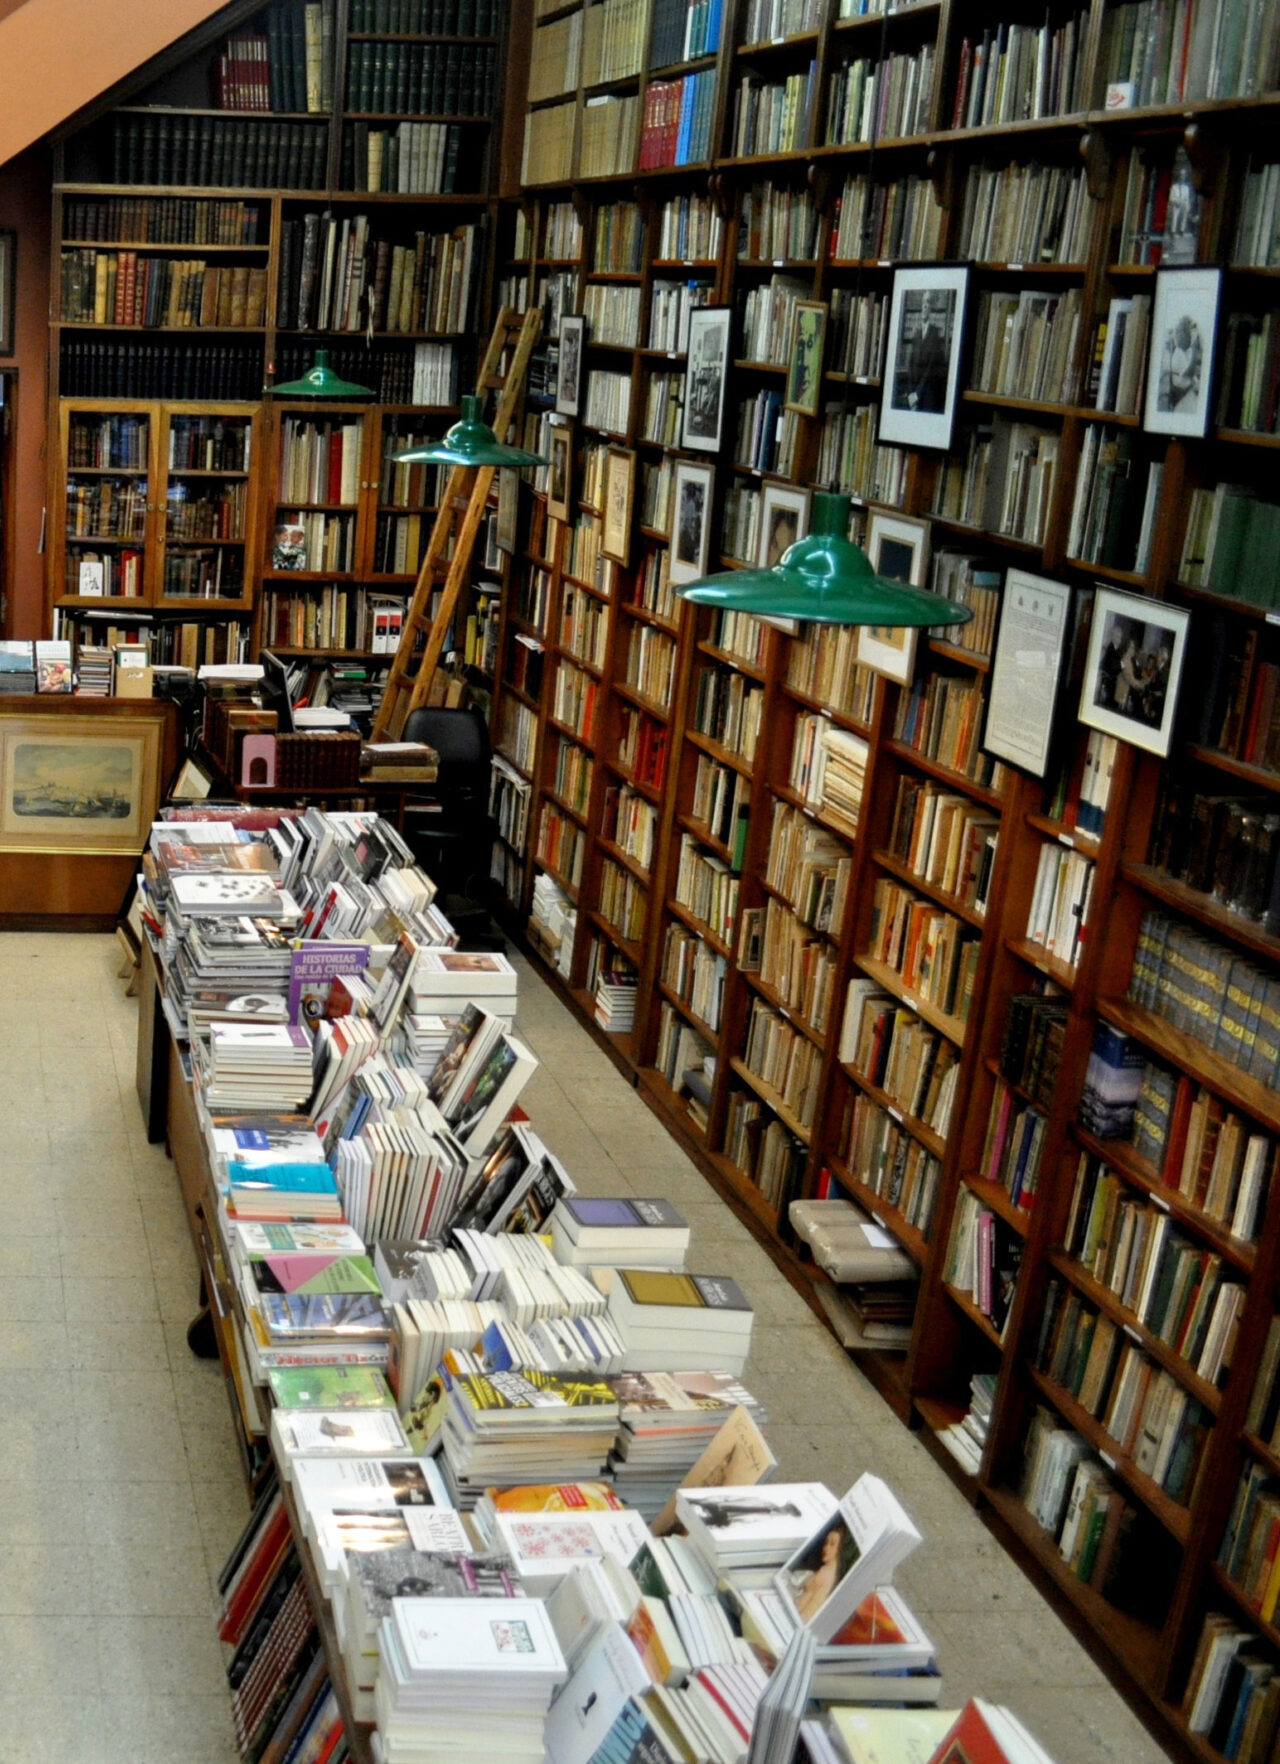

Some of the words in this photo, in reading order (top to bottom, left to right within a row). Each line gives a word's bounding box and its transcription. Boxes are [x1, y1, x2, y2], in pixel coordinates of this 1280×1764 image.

[302, 954, 356, 964] HISTORIAS
[295, 965, 307, 974] DE
[309, 964, 322, 974] LA
[325, 964, 362, 974] CIUDAD
